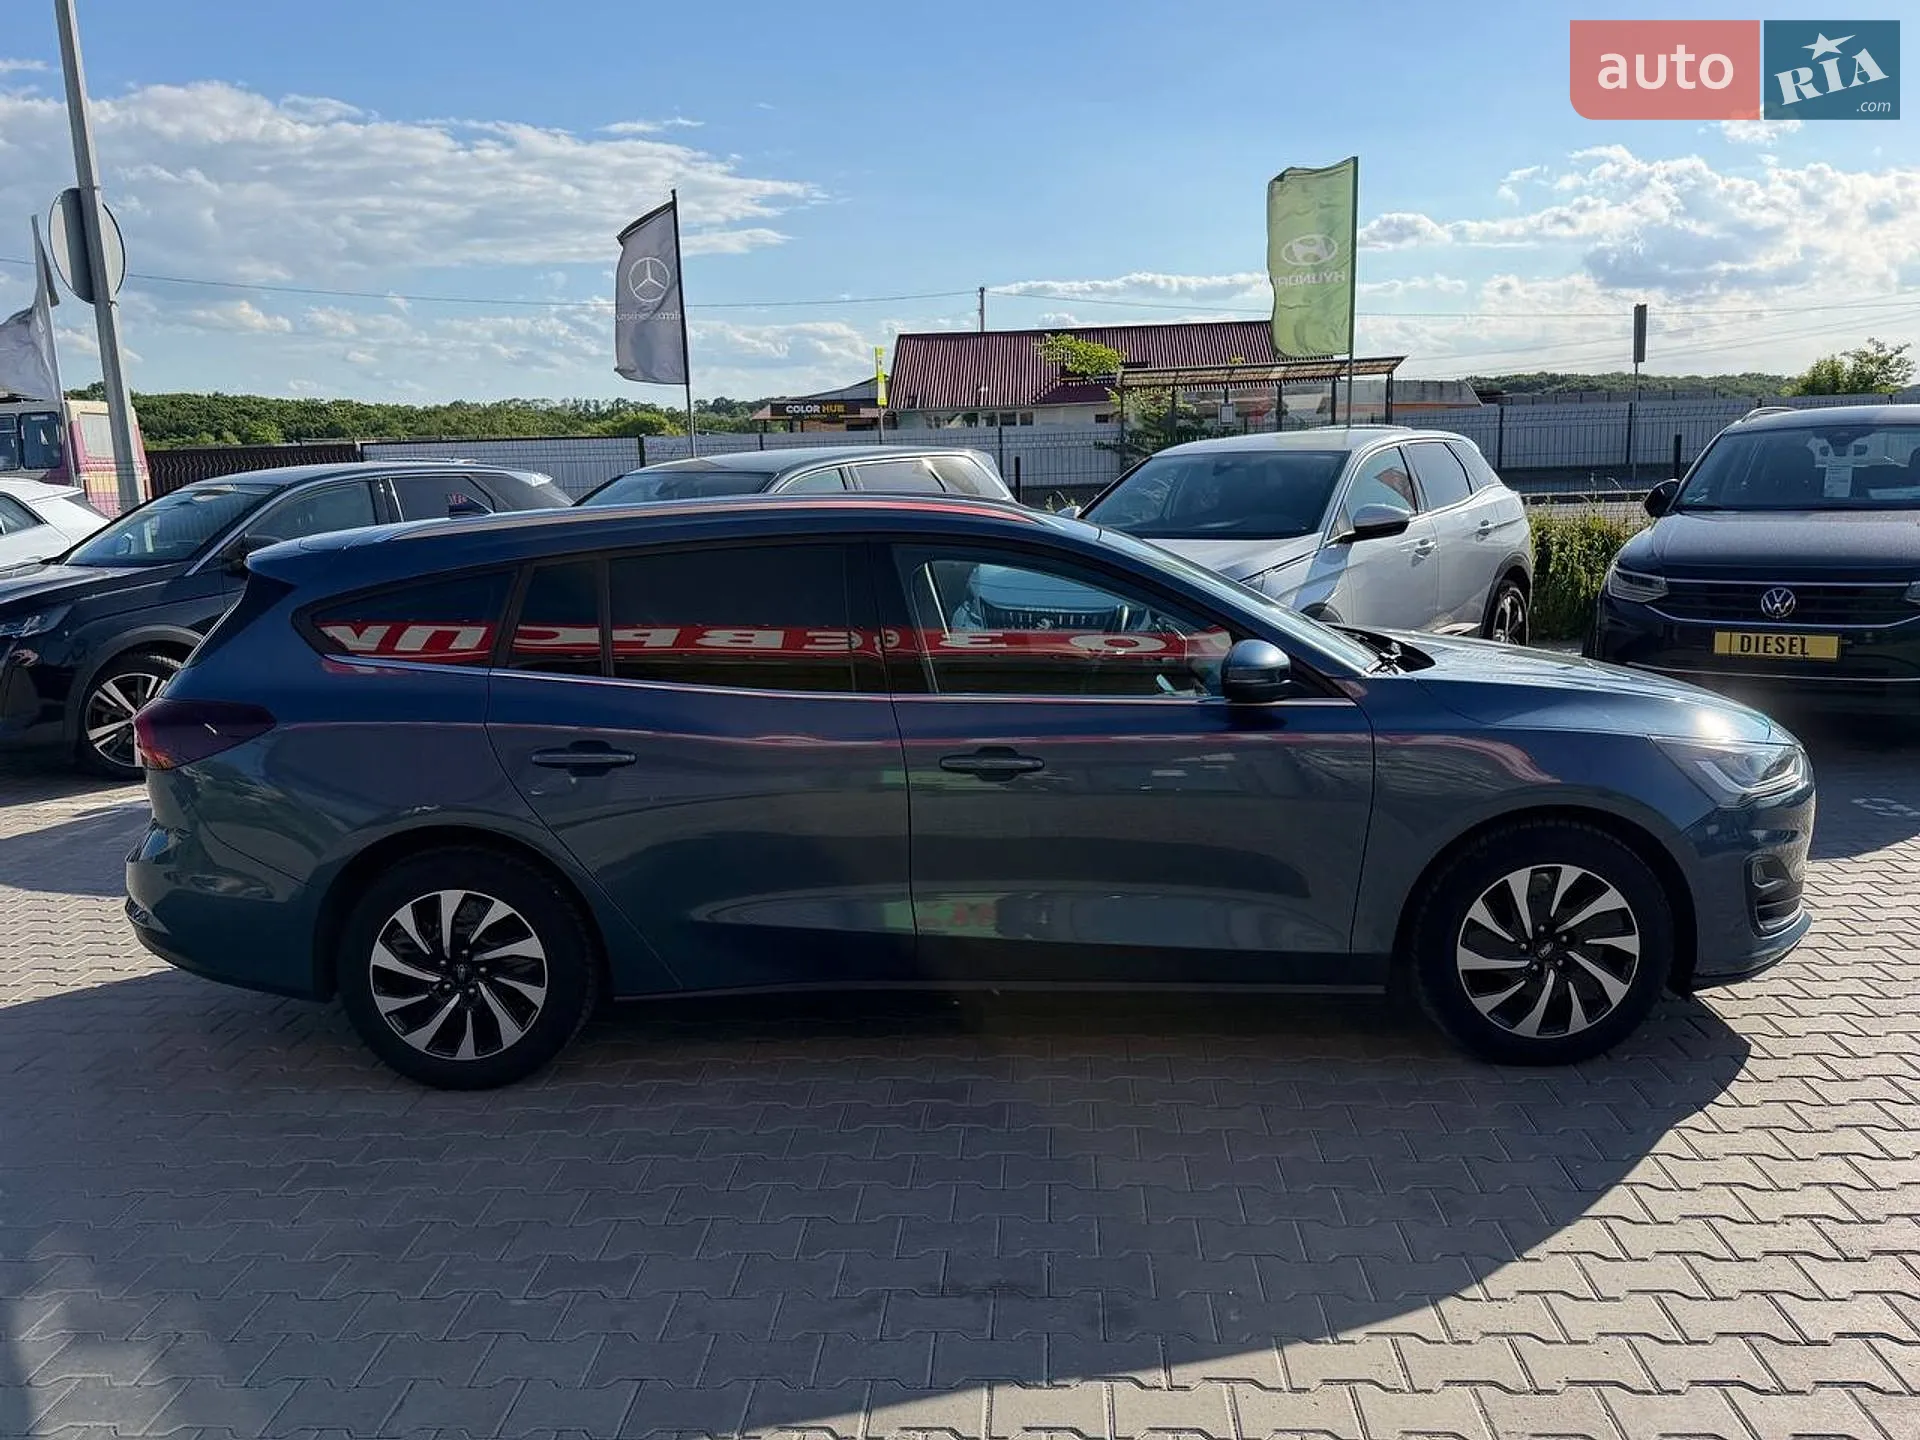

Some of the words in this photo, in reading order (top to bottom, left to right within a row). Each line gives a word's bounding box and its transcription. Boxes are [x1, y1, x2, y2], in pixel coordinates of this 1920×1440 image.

[786, 405, 821, 414] COLOR
[822, 405, 845, 413] HUB
[1739, 634, 1809, 656] DIESEL
